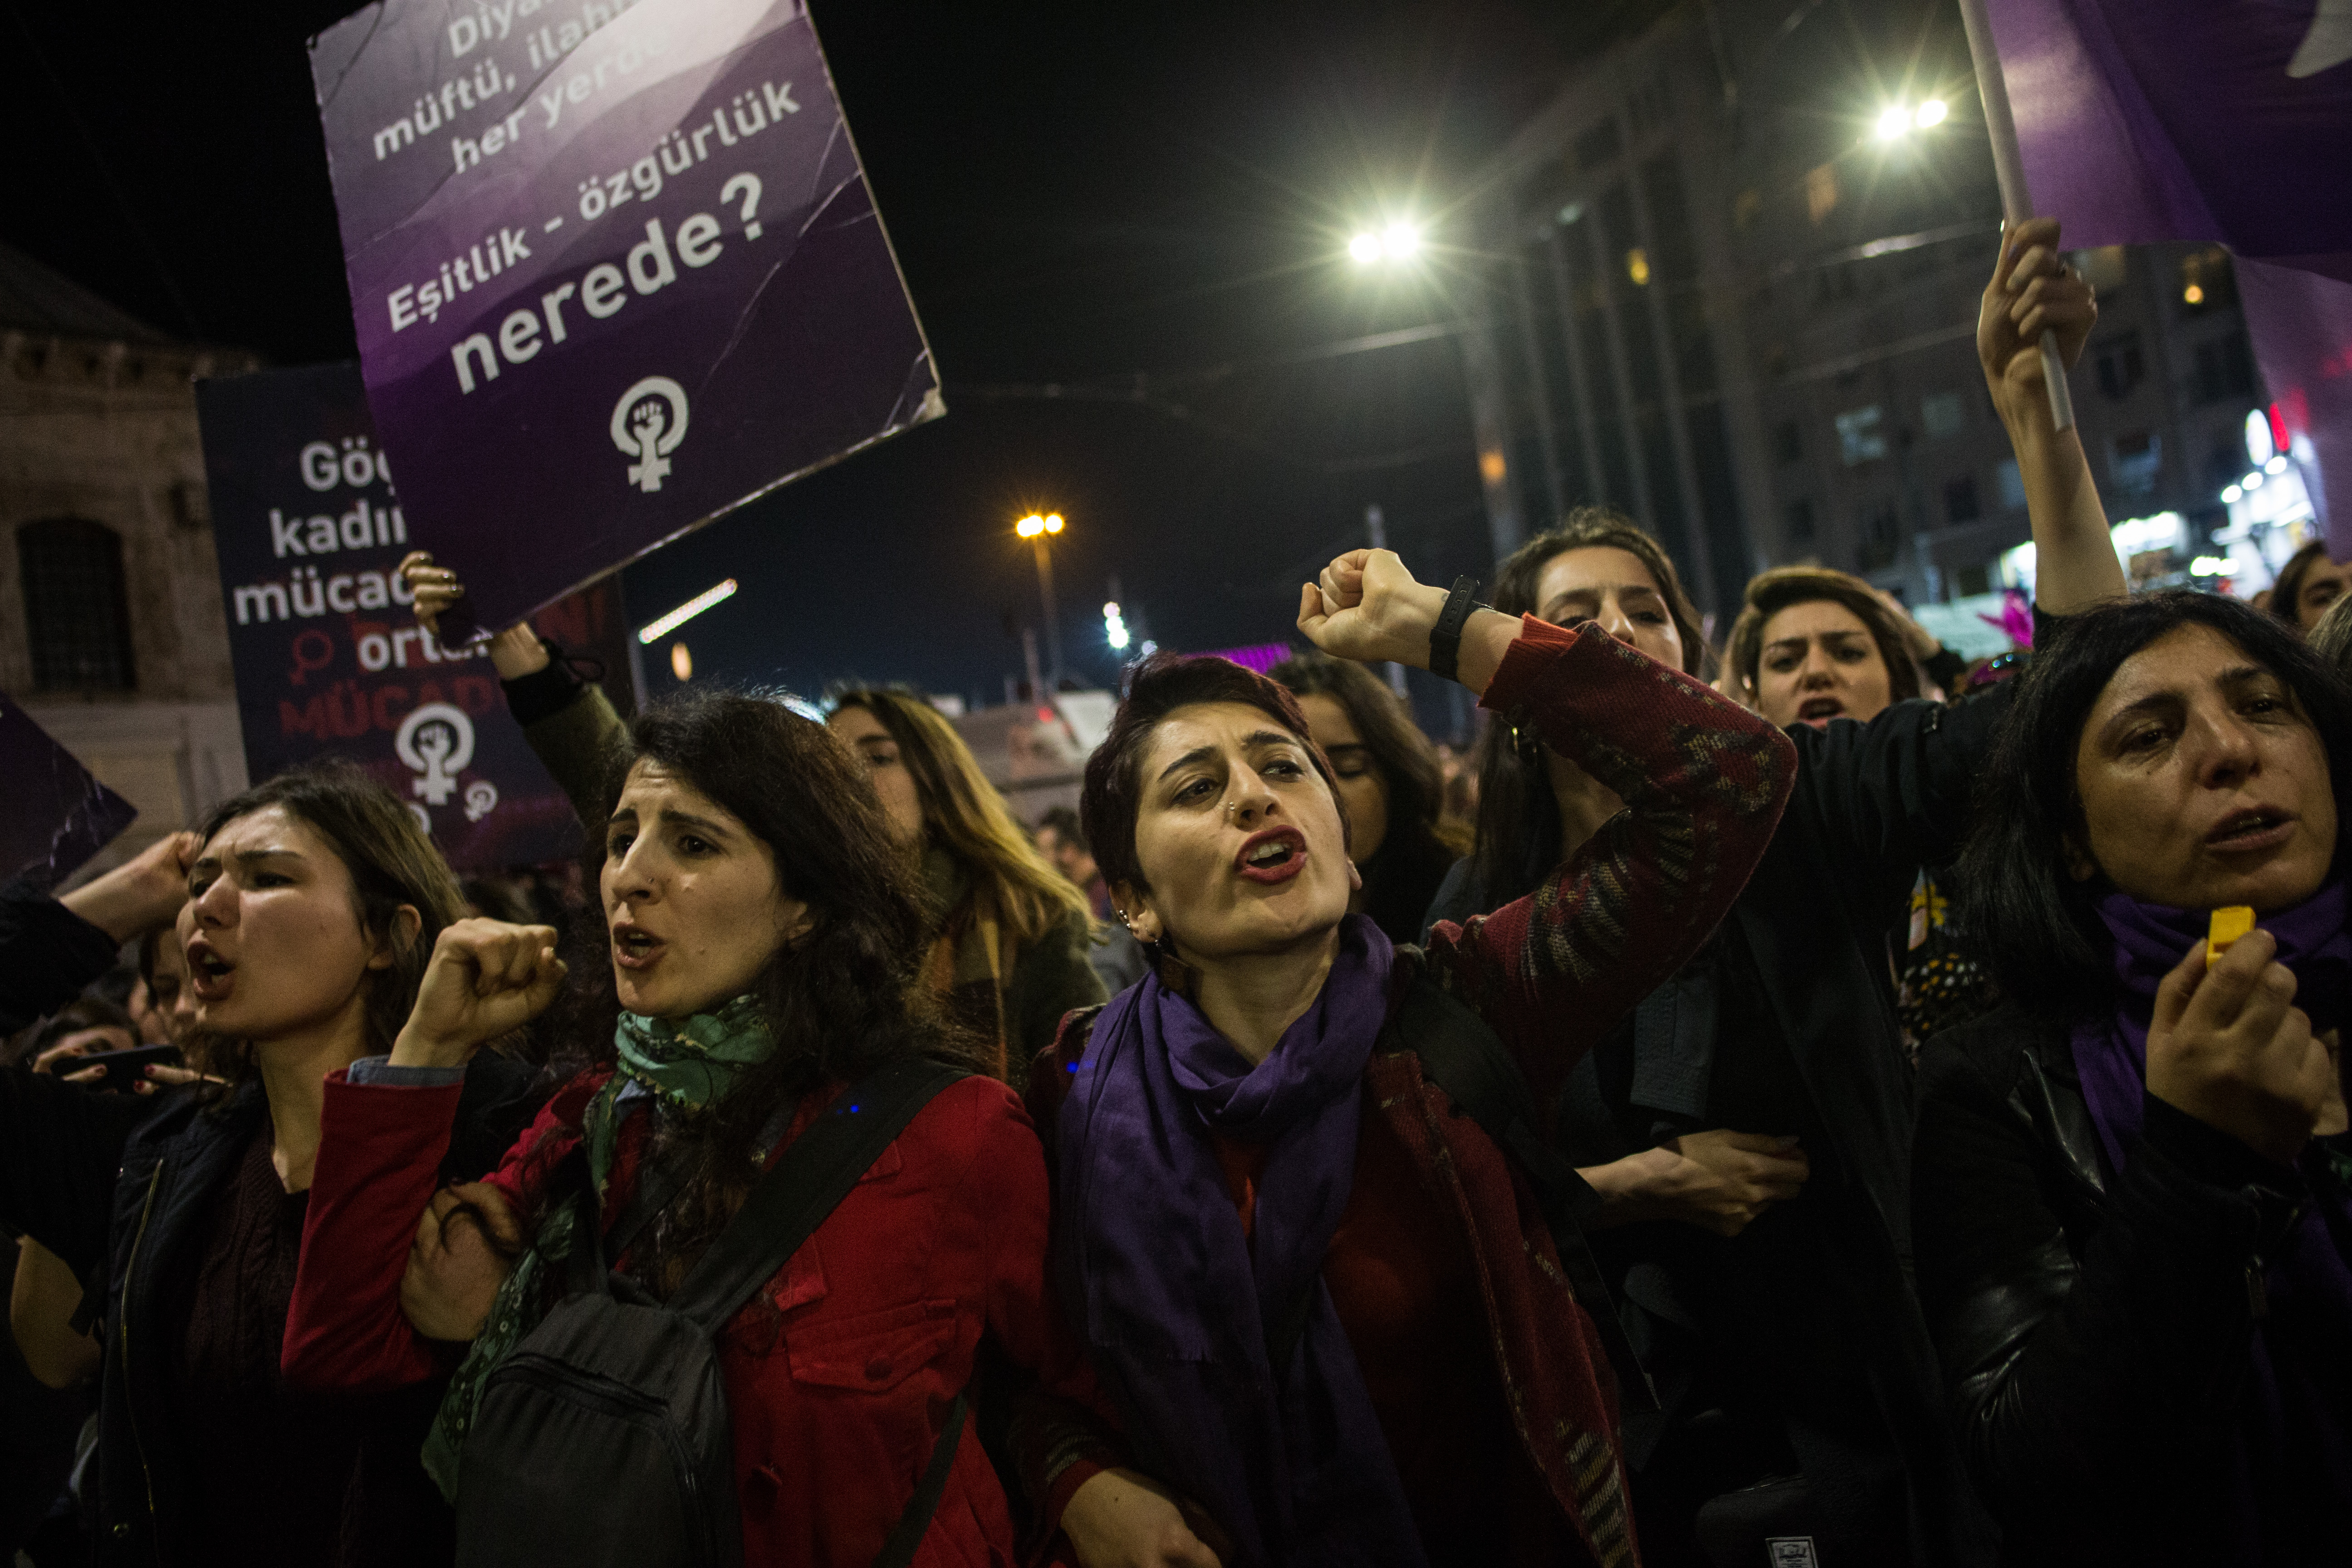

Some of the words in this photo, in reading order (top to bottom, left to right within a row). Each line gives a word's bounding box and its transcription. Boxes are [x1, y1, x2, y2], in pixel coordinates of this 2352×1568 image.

[448, 0, 554, 58] Diya
[373, 57, 515, 160] müftü,
[453, 107, 526, 174] her
[387, 228, 532, 333] Eşitlik
[577, 81, 801, 221] özgürlük
[450, 172, 763, 394] nerede?
[358, 623, 489, 671] ort
[278, 674, 505, 740] MÜCAD
